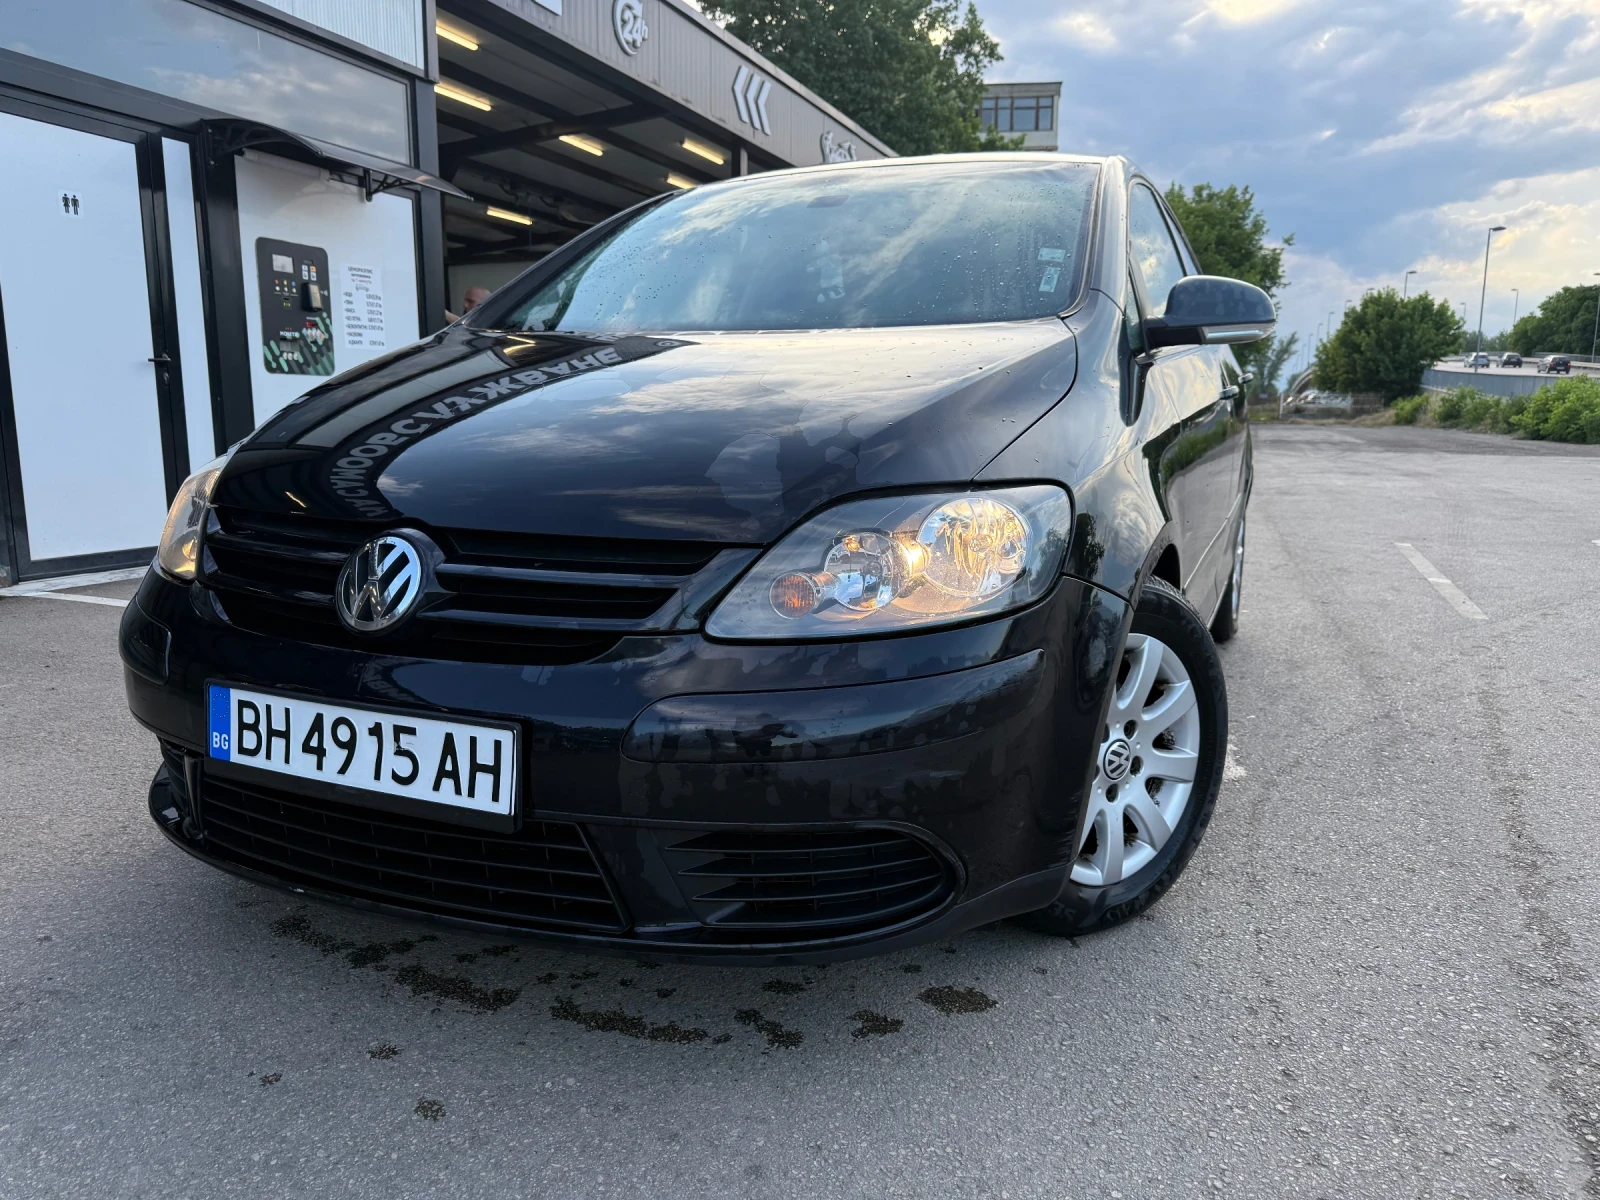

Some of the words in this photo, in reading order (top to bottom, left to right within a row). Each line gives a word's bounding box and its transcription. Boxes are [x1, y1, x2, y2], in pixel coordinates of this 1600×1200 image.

[622, 9, 648, 47] 24h
[212, 730, 229, 751] BG
[237, 698, 291, 765] BH
[301, 712, 421, 787] 4915
[432, 731, 503, 803] AH
